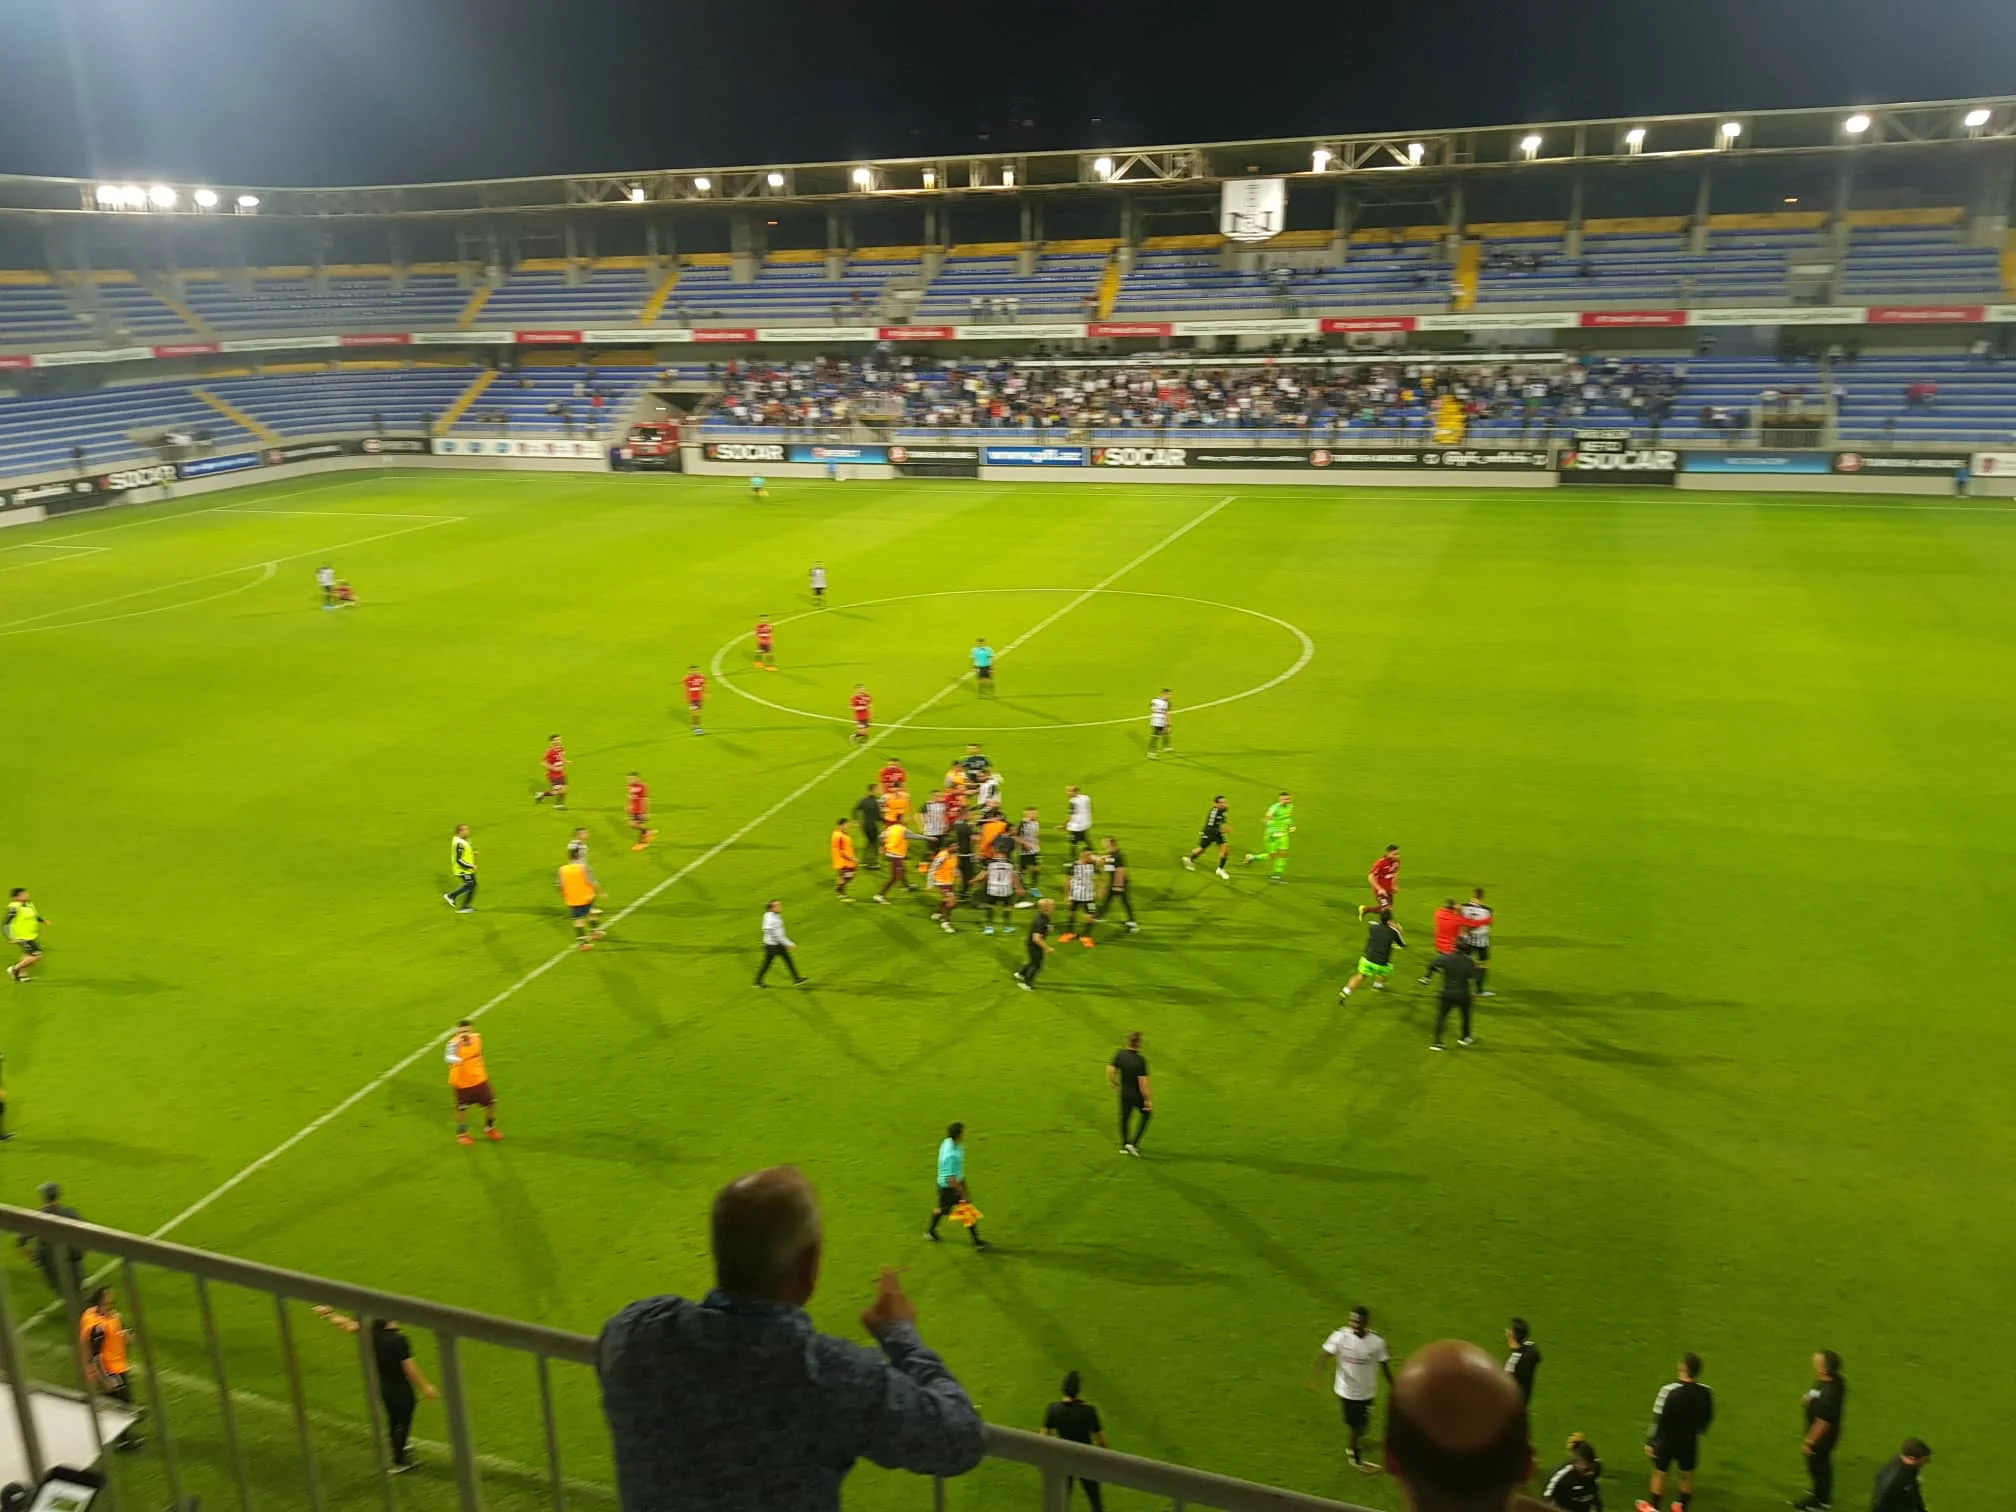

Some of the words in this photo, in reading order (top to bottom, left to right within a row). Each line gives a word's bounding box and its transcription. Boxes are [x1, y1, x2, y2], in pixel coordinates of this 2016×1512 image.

[717, 444, 784, 460] SOCAR
[1104, 448, 1187, 465] SOCAR
[1575, 450, 1677, 469] SOCAR
[107, 465, 178, 490] SOCAR
